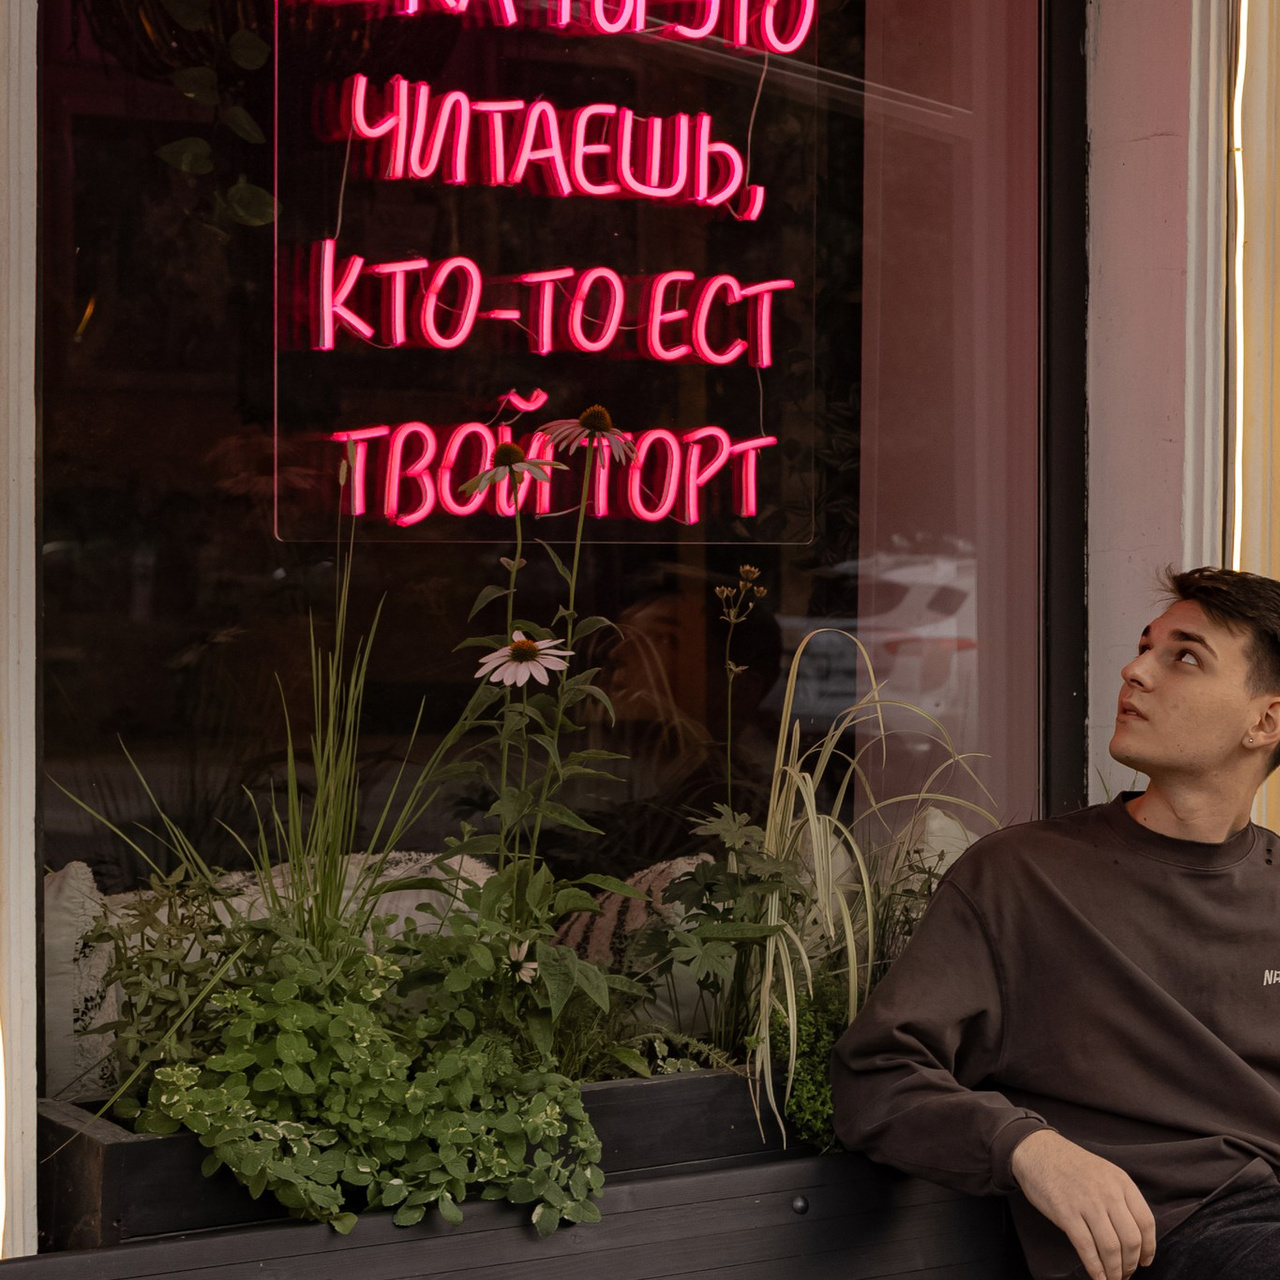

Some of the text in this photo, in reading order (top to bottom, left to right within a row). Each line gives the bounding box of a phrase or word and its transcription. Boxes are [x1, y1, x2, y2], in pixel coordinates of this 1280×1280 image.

[352, 74, 766, 220] ЧИТАЕШЬ,
[310, 238, 795, 368] КТО-ТО ЕСТ
[332, 387, 778, 526] ТВОЙ ТОРТ
